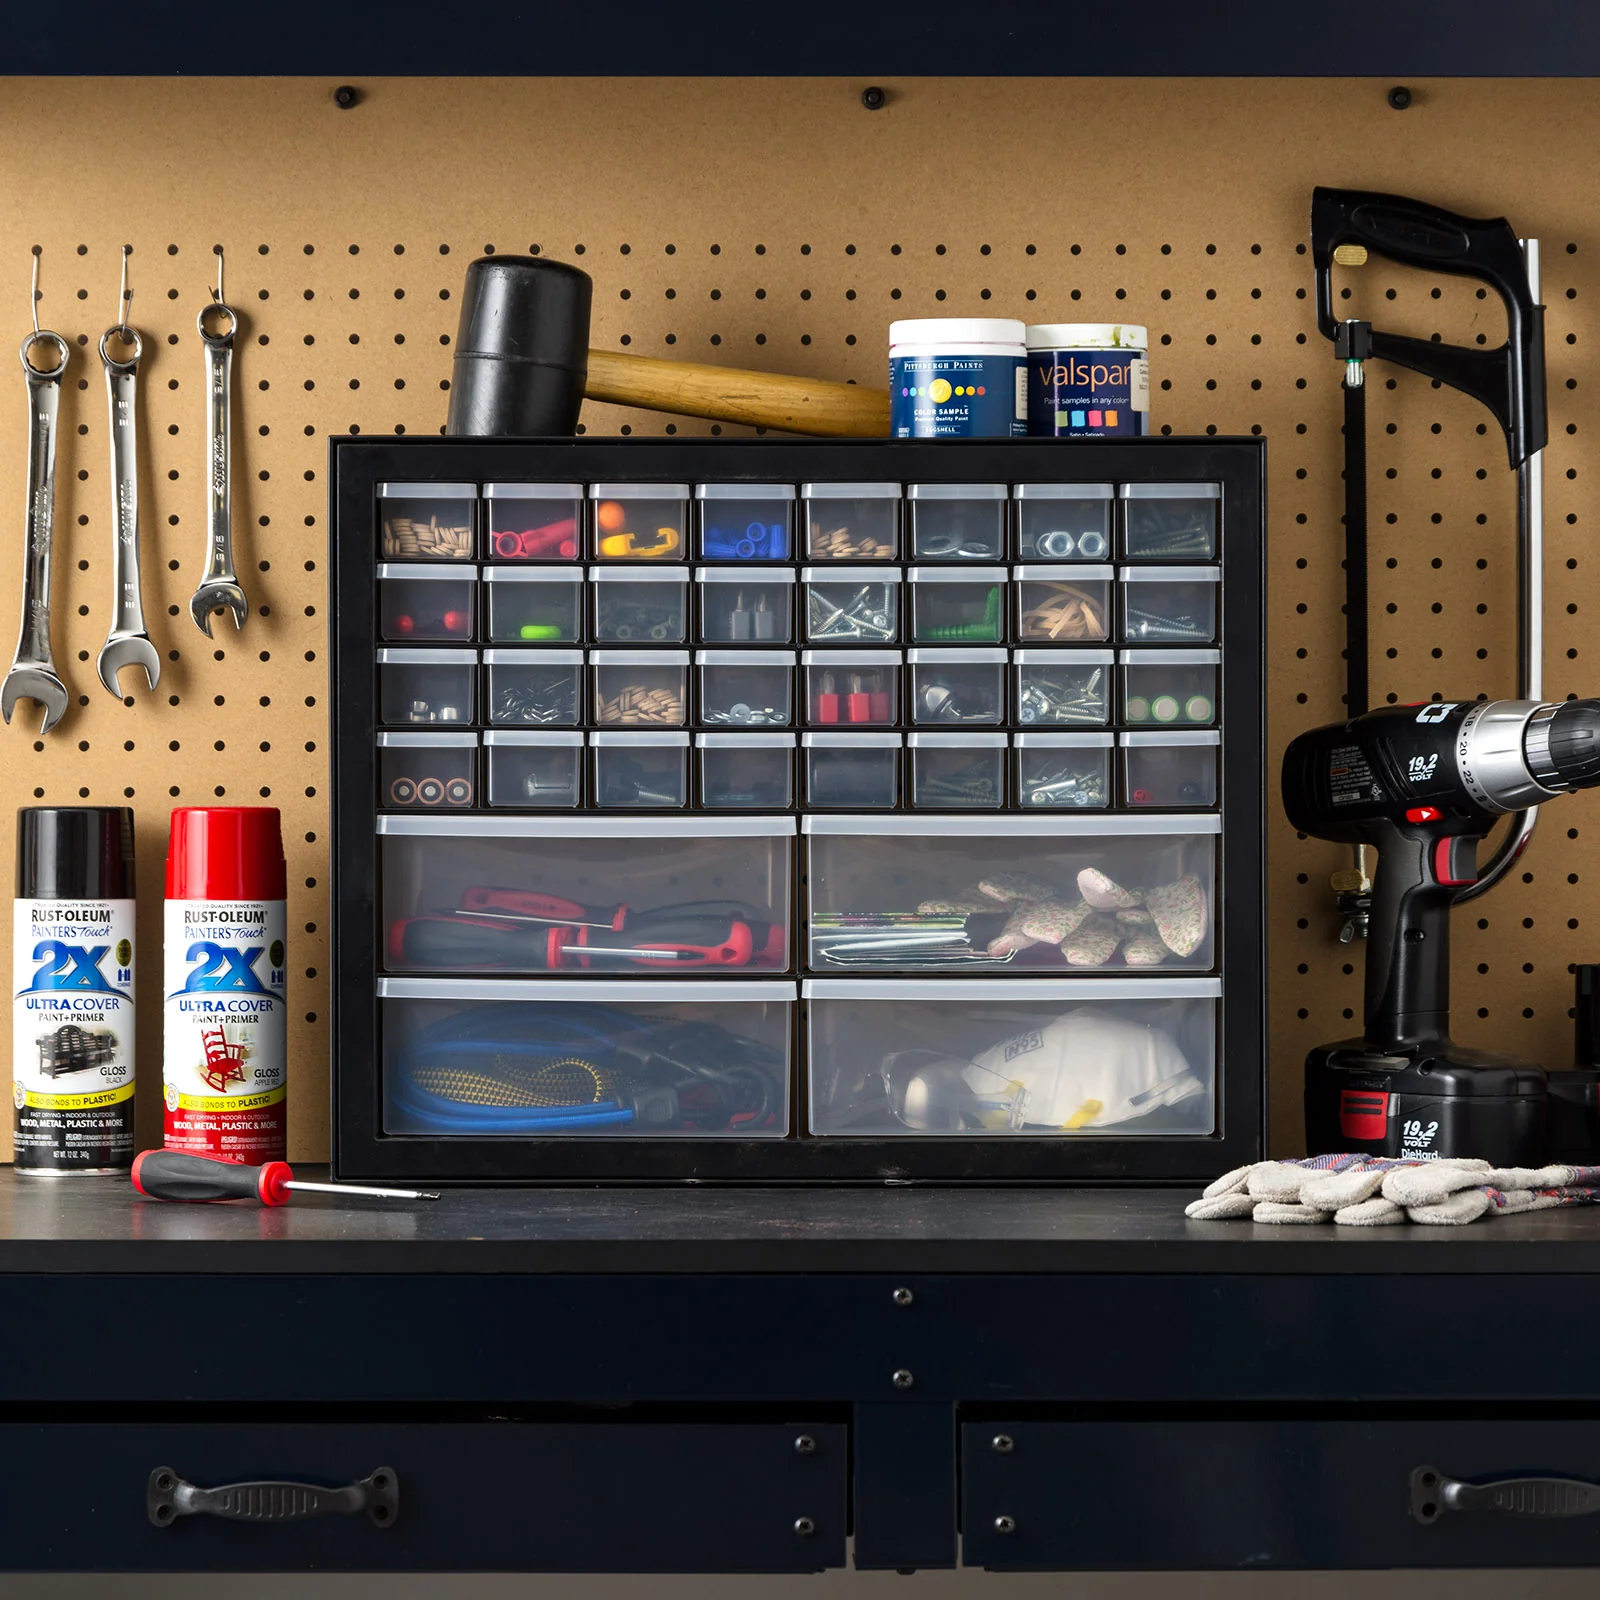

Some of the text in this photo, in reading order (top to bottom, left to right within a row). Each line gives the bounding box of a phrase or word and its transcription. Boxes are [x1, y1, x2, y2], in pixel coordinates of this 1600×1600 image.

[954, 361, 983, 370] PAINTS
[1040, 357, 1132, 392] valspar
[1062, 397, 1090, 405] samples
[1465, 716, 1476, 727] 18
[1460, 741, 1468, 756] 20
[1408, 753, 1438, 772] 19.2
[1409, 773, 1433, 782] VOLT
[1463, 770, 1475, 785] 22
[76, 925, 110, 937] Touch
[231, 926, 264, 938] Touch
[31, 939, 112, 989] 2X
[185, 941, 266, 991] 2X
[26, 998, 120, 1010] ULTRA COVER
[180, 1000, 273, 1012] ULTRA COVER
[1008, 1033, 1039, 1057] N95
[100, 1066, 126, 1076] GLOSS
[254, 1068, 279, 1078] GLOSS
[72, 1098, 81, 1106] TO
[83, 1093, 117, 1105] PLASTIC!
[184, 1099, 199, 1107] ALSO
[201, 1101, 224, 1109] BONDS
[238, 1096, 271, 1107] PLASTIC!
[20, 1119, 39, 1128] WOOD,
[40, 1119, 66, 1128] METAL,
[67, 1120, 98, 1128] PLASTIC
[105, 1119, 123, 1127] MORE
[173, 1121, 193, 1131] WOOD,
[194, 1121, 221, 1131] METAL,
[222, 1122, 253, 1130] PLASTIC
[260, 1121, 278, 1129] MORE
[1403, 1120, 1439, 1137] 19.2
[1401, 1148, 1439, 1160] DieHard
